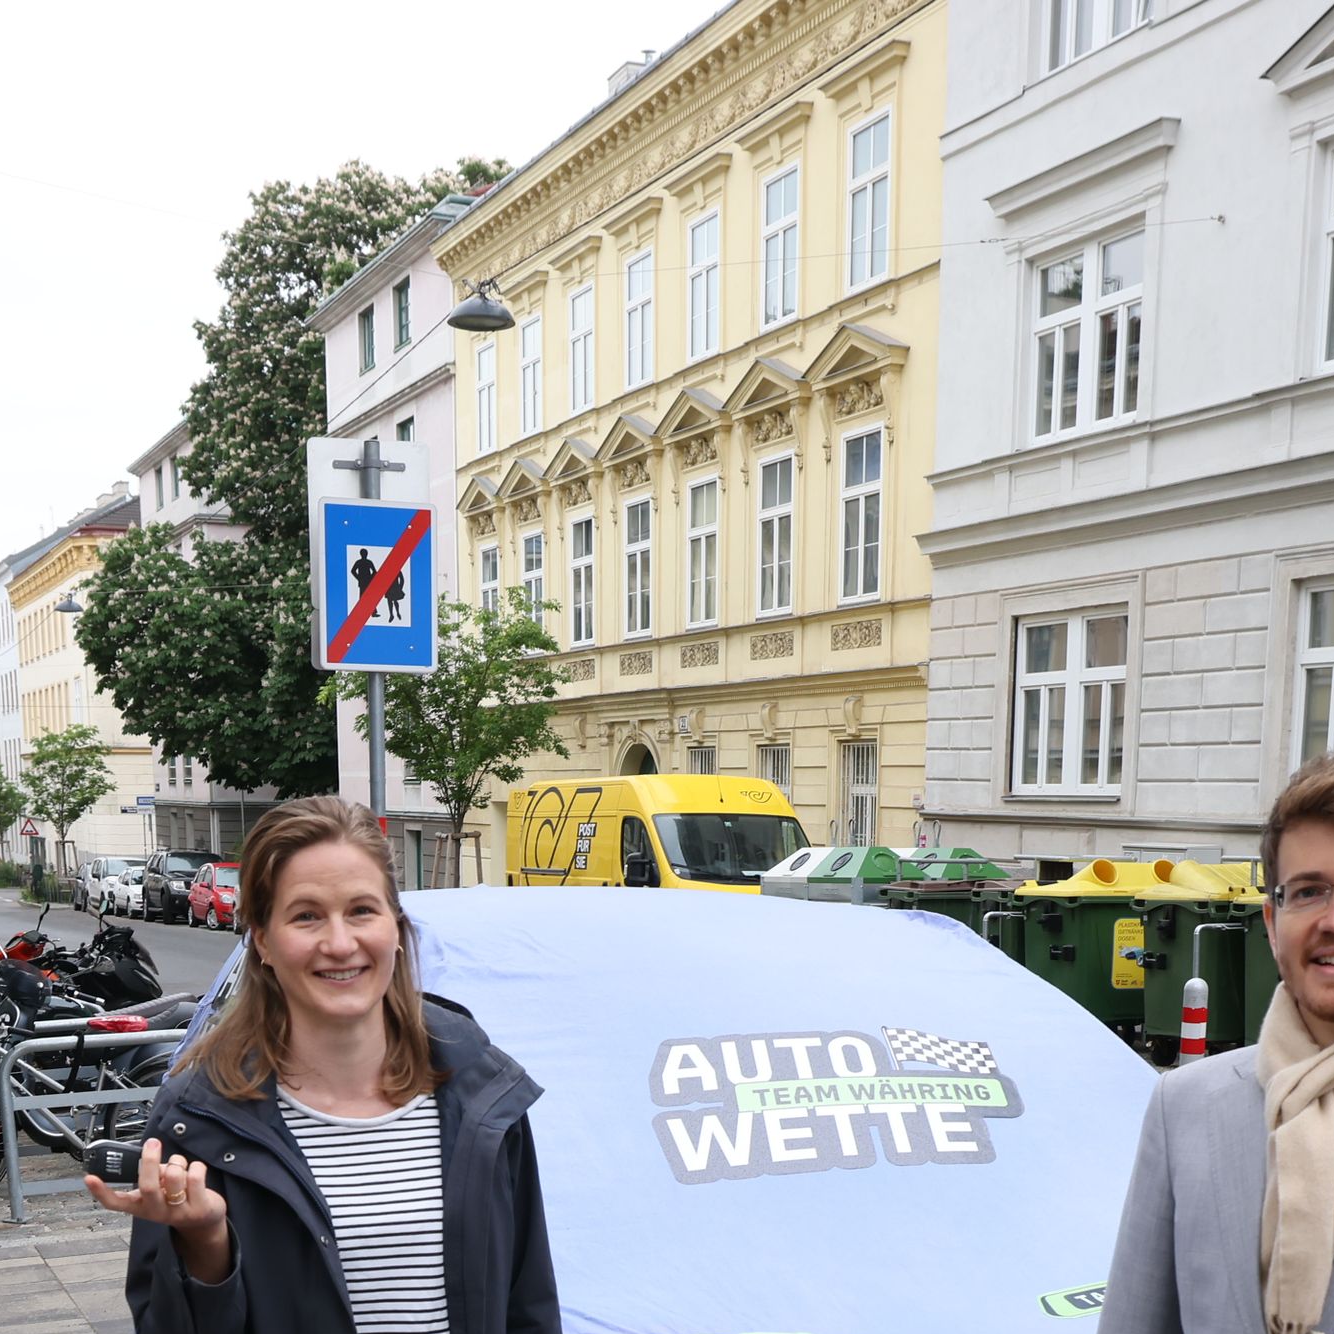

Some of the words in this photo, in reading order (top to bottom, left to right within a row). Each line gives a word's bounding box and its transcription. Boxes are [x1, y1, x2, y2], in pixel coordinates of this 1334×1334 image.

[578, 823, 596, 836] POST
[575, 855, 587, 869] SIE
[661, 1035, 878, 1095] AUTO
[752, 1084, 841, 1107] TEAM
[847, 1079, 991, 1102] WÄHRING
[665, 1101, 980, 1173] WETTE
[1073, 1288, 1107, 1306] TA
